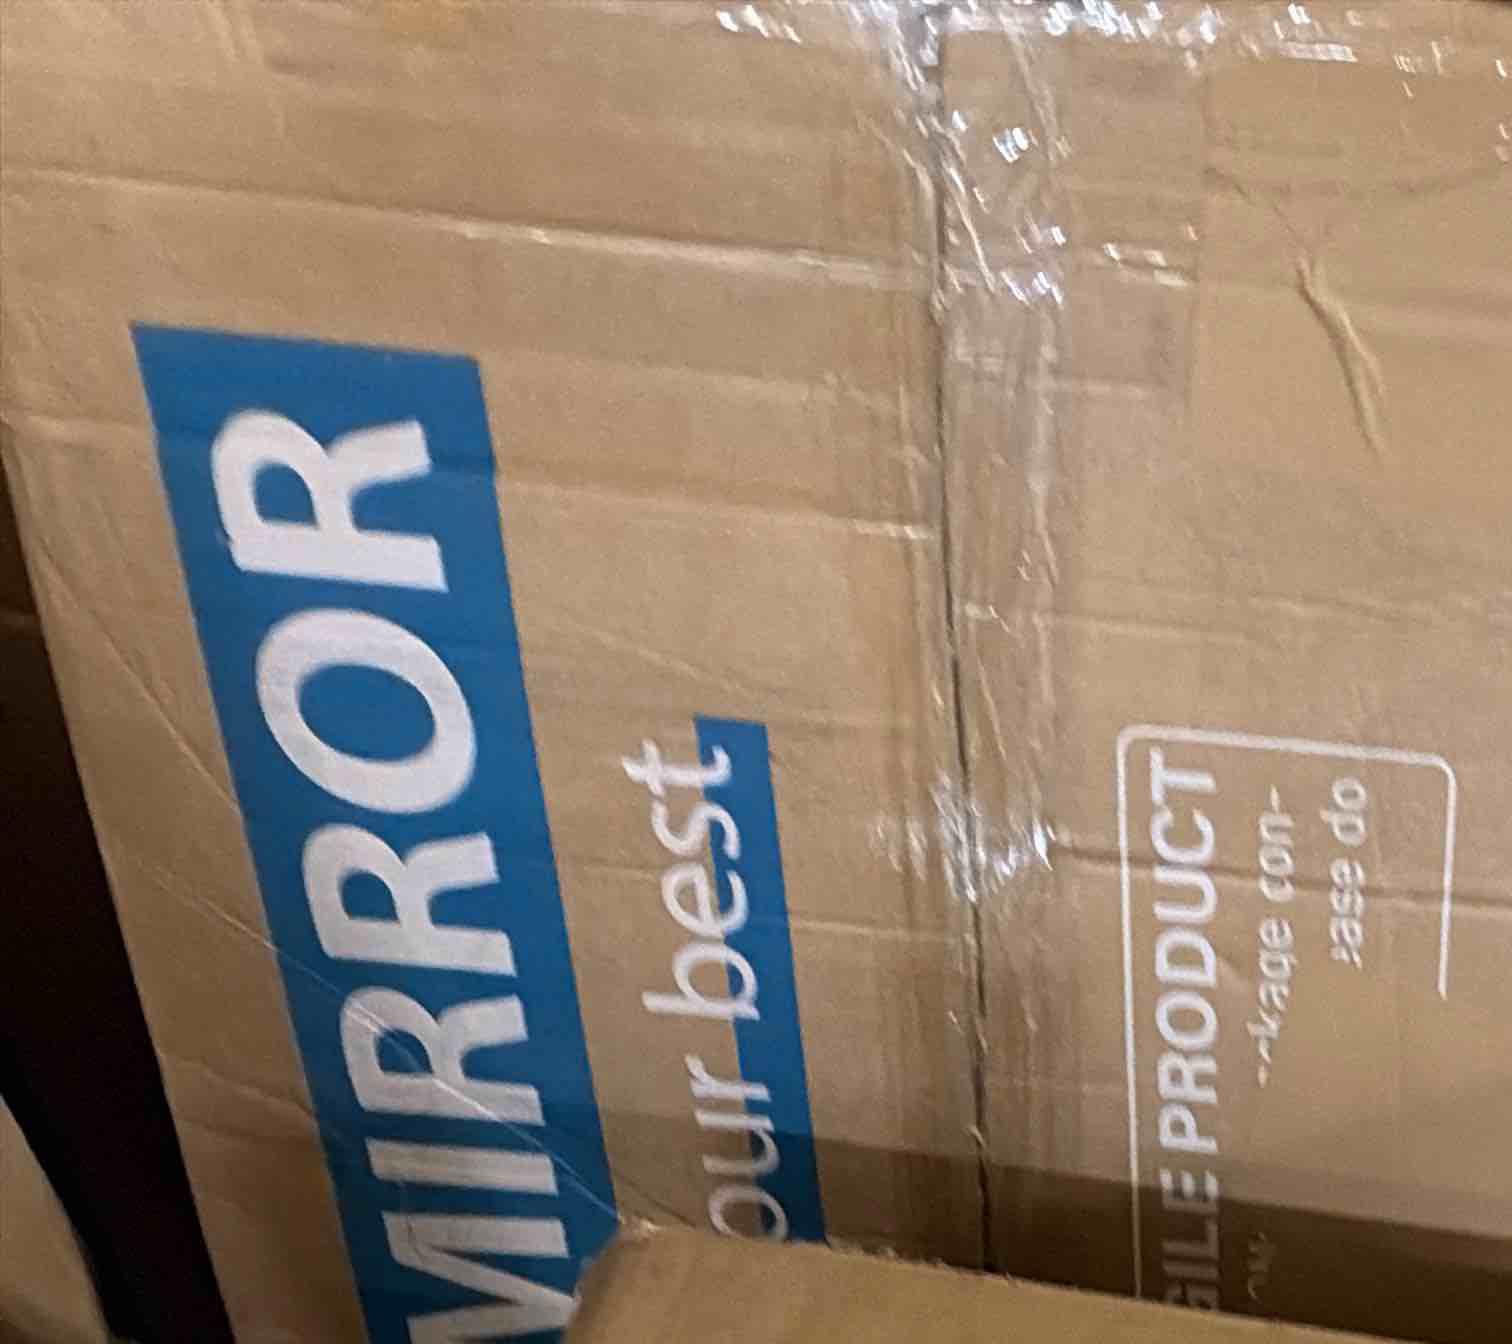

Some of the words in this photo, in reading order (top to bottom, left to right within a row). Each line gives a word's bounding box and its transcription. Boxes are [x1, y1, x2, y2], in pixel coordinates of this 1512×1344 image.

[622, 738, 759, 1021] best
[1149, 748, 1219, 1154] PRODUCT
[1319, 776, 1368, 848] do
